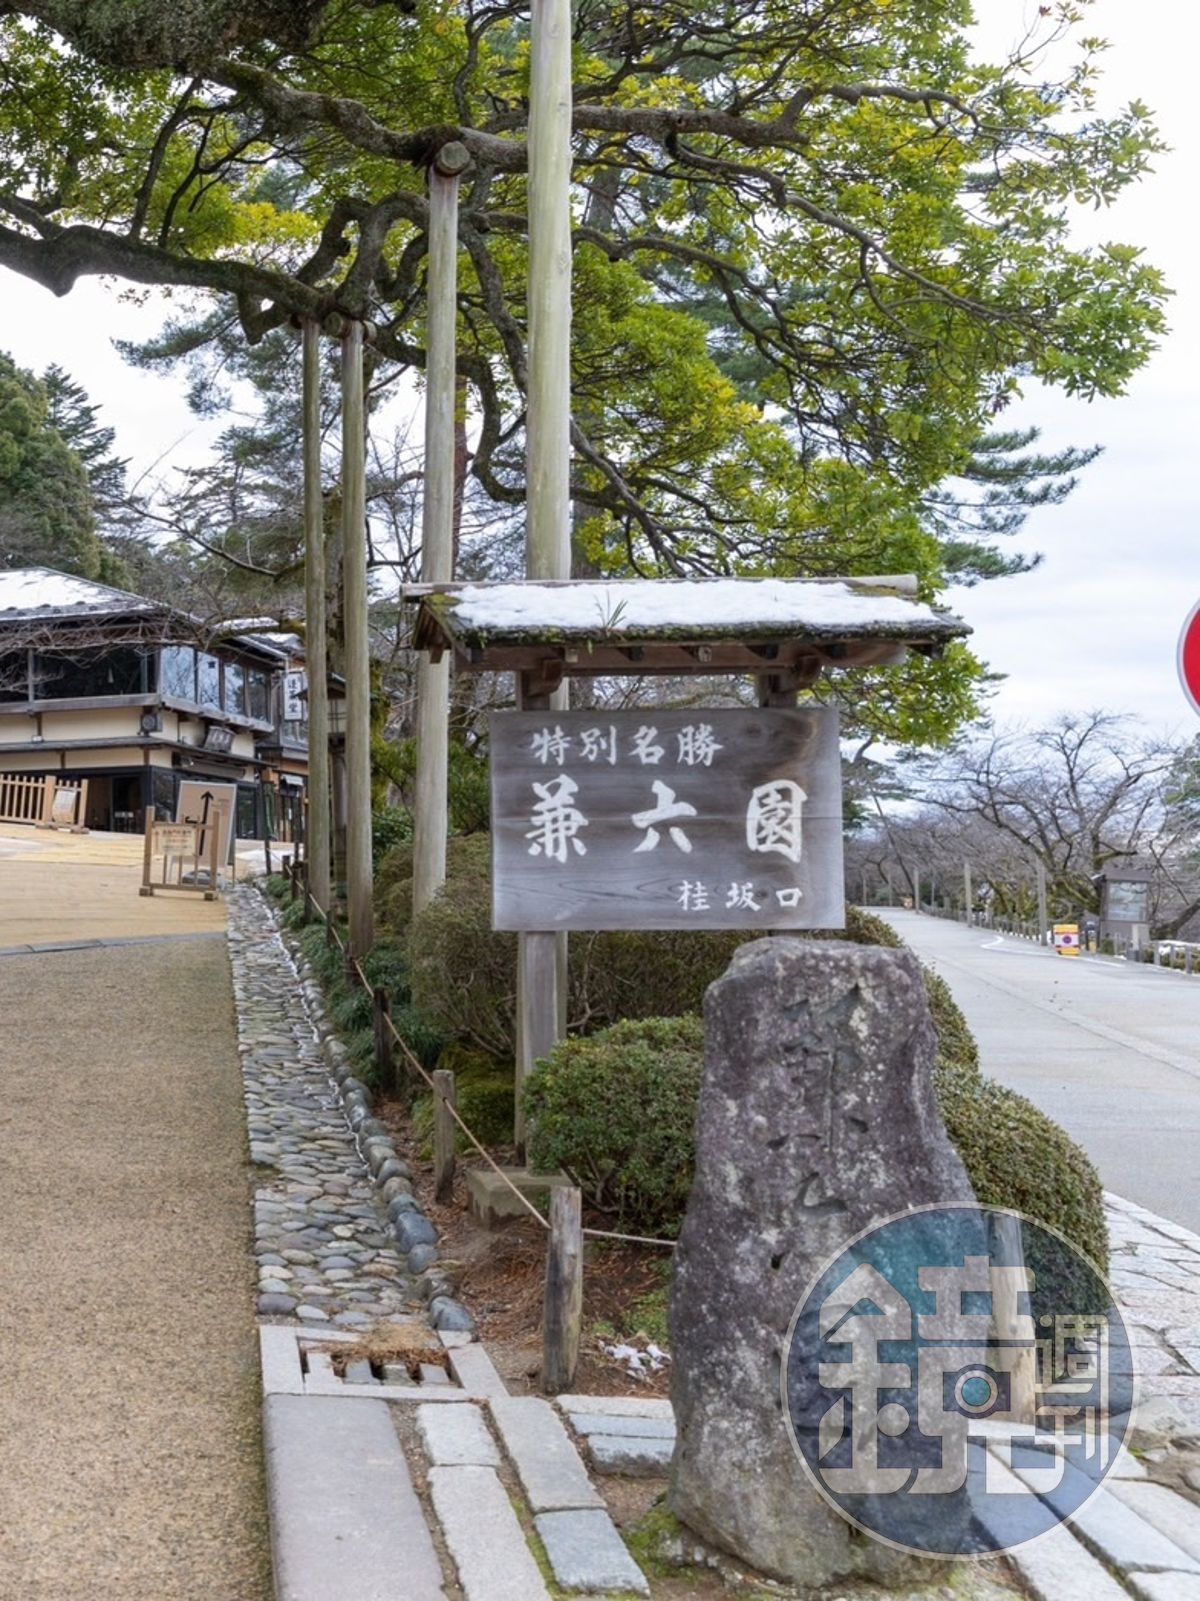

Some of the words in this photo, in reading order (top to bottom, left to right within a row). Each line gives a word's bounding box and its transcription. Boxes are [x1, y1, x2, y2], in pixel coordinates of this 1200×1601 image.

[529, 722, 724, 767] 特別名勝
[524, 773, 808, 864] 兼六園
[677, 880, 803, 912] 桂坂口
